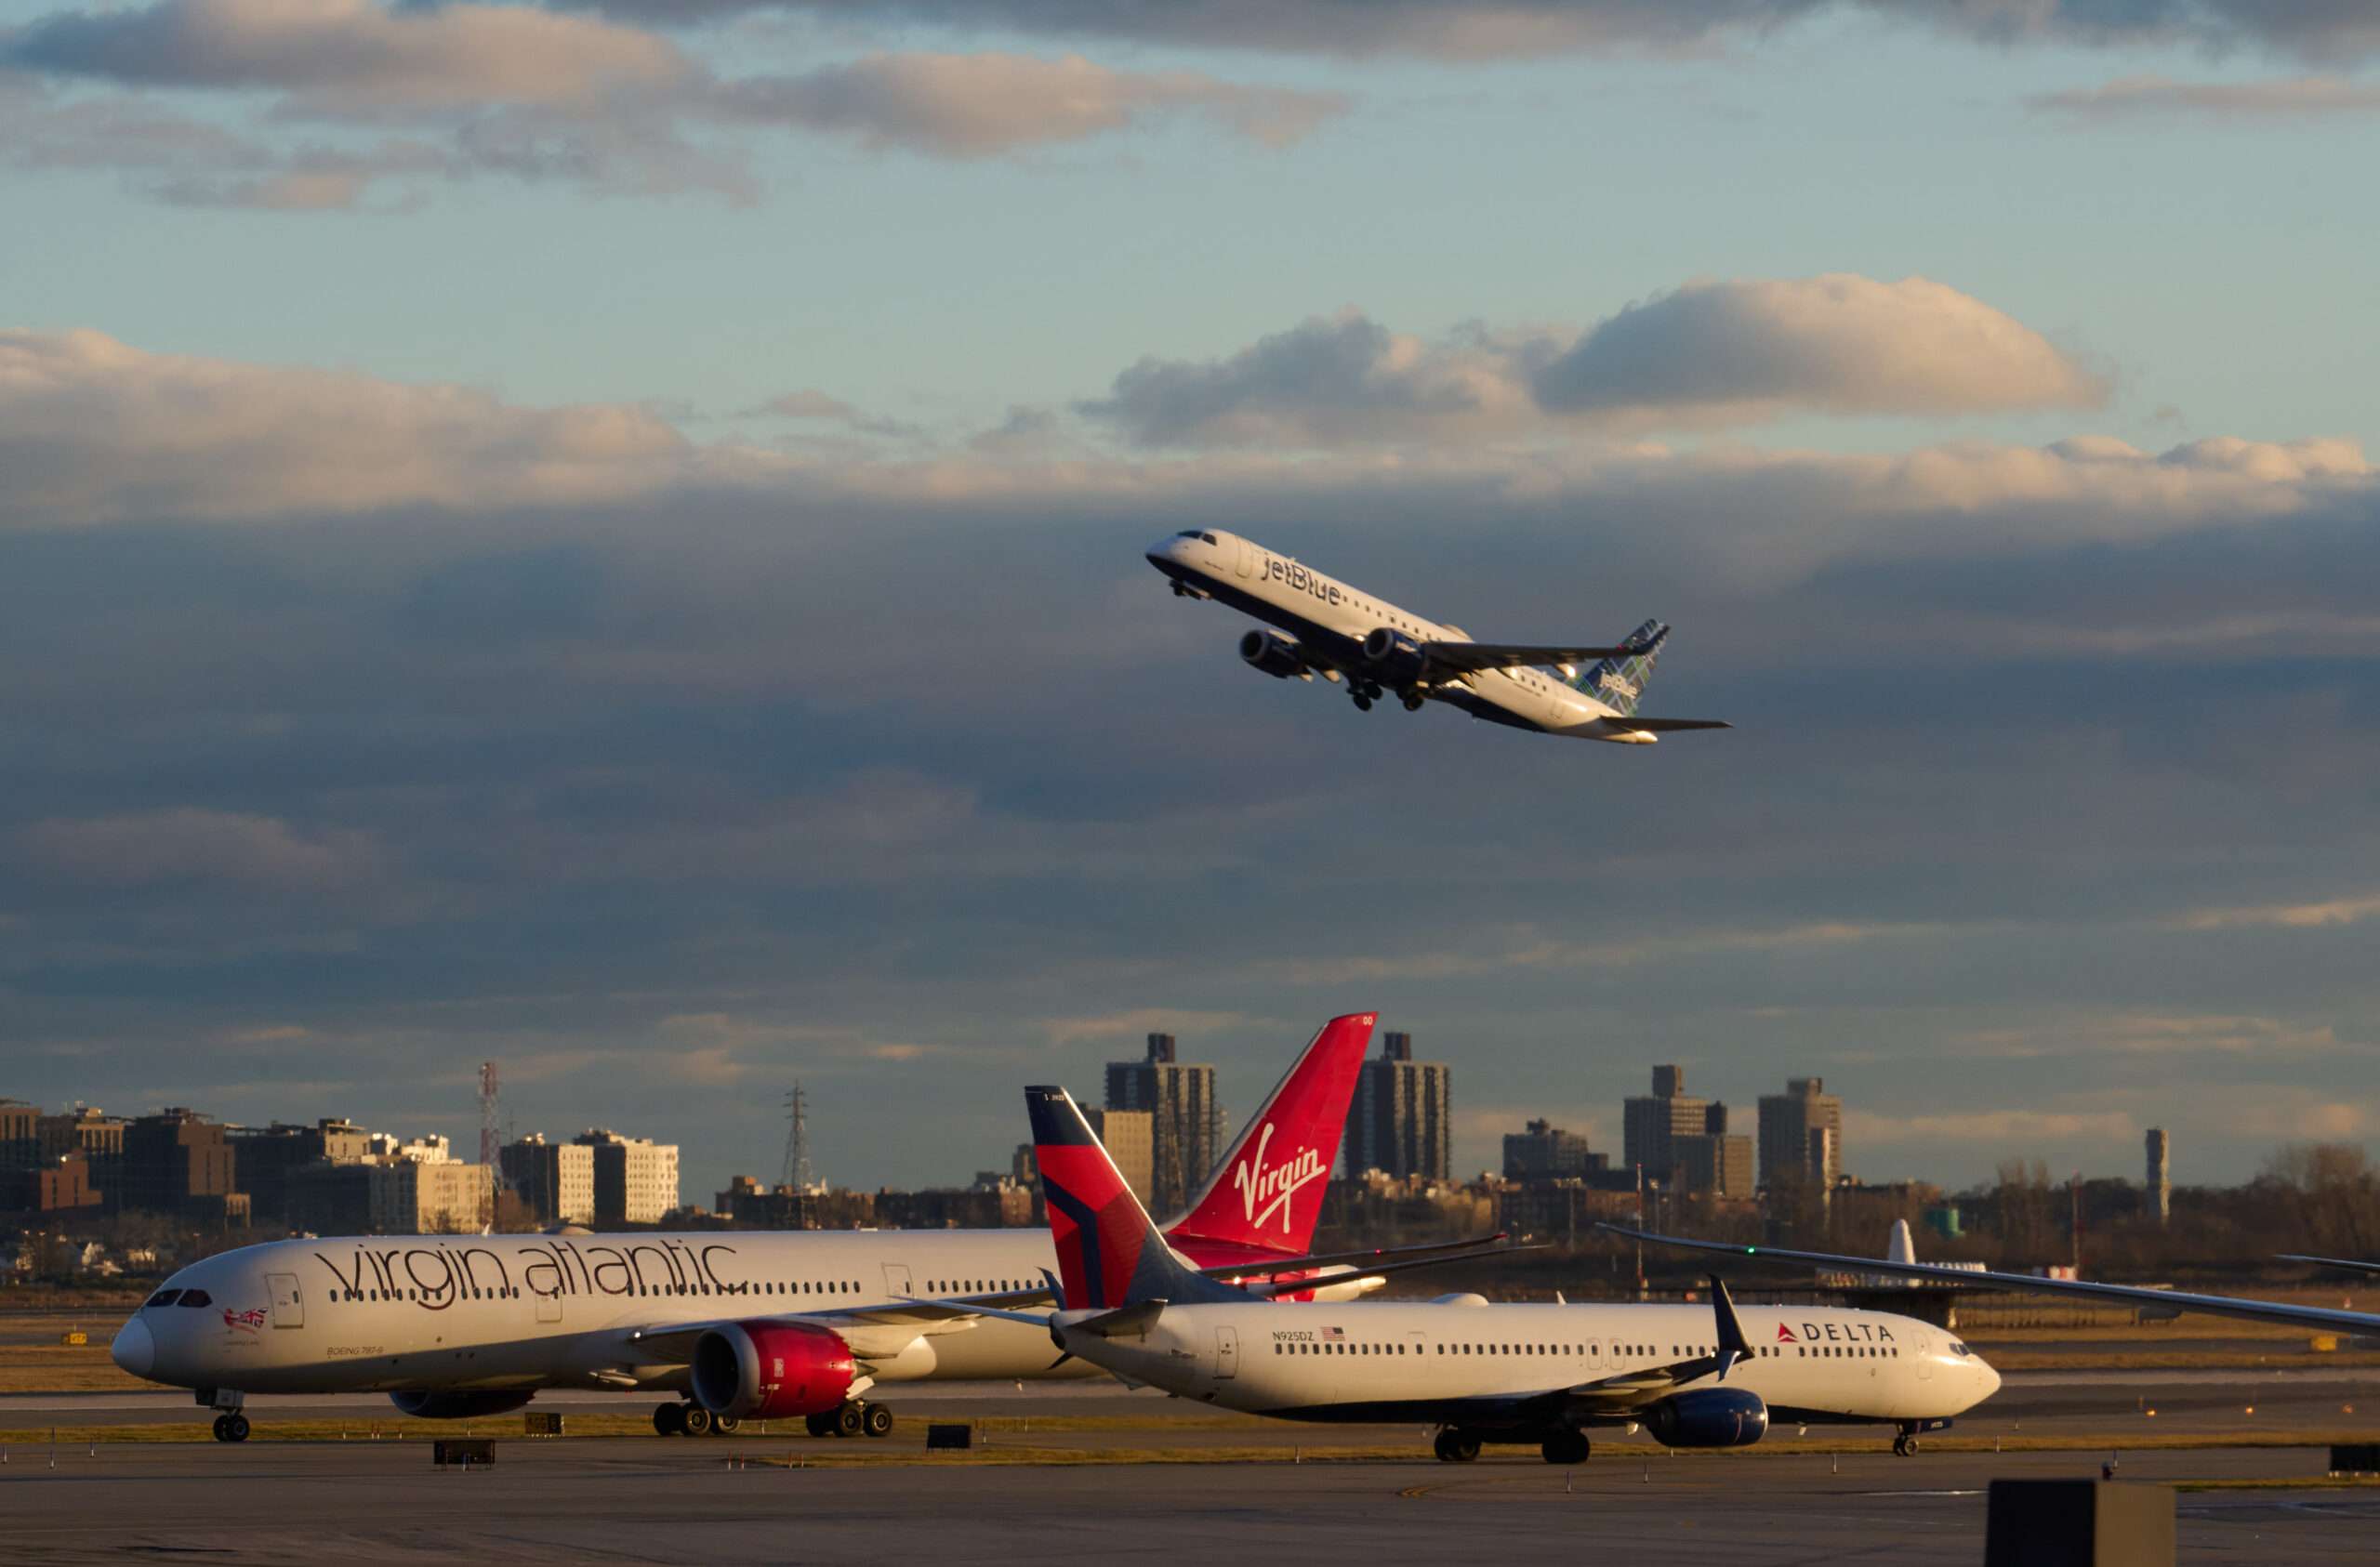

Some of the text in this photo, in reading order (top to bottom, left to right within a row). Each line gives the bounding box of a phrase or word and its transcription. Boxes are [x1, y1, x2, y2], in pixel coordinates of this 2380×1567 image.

[1261, 553, 1341, 606] jetBlue
[1235, 1123, 1326, 1234] Virgin
[314, 1240, 747, 1310] virgin atlantic
[1272, 1331, 1315, 1342] N925DZ
[1802, 1323, 1895, 1342] DELTA
[326, 1346, 360, 1356] BOEING
